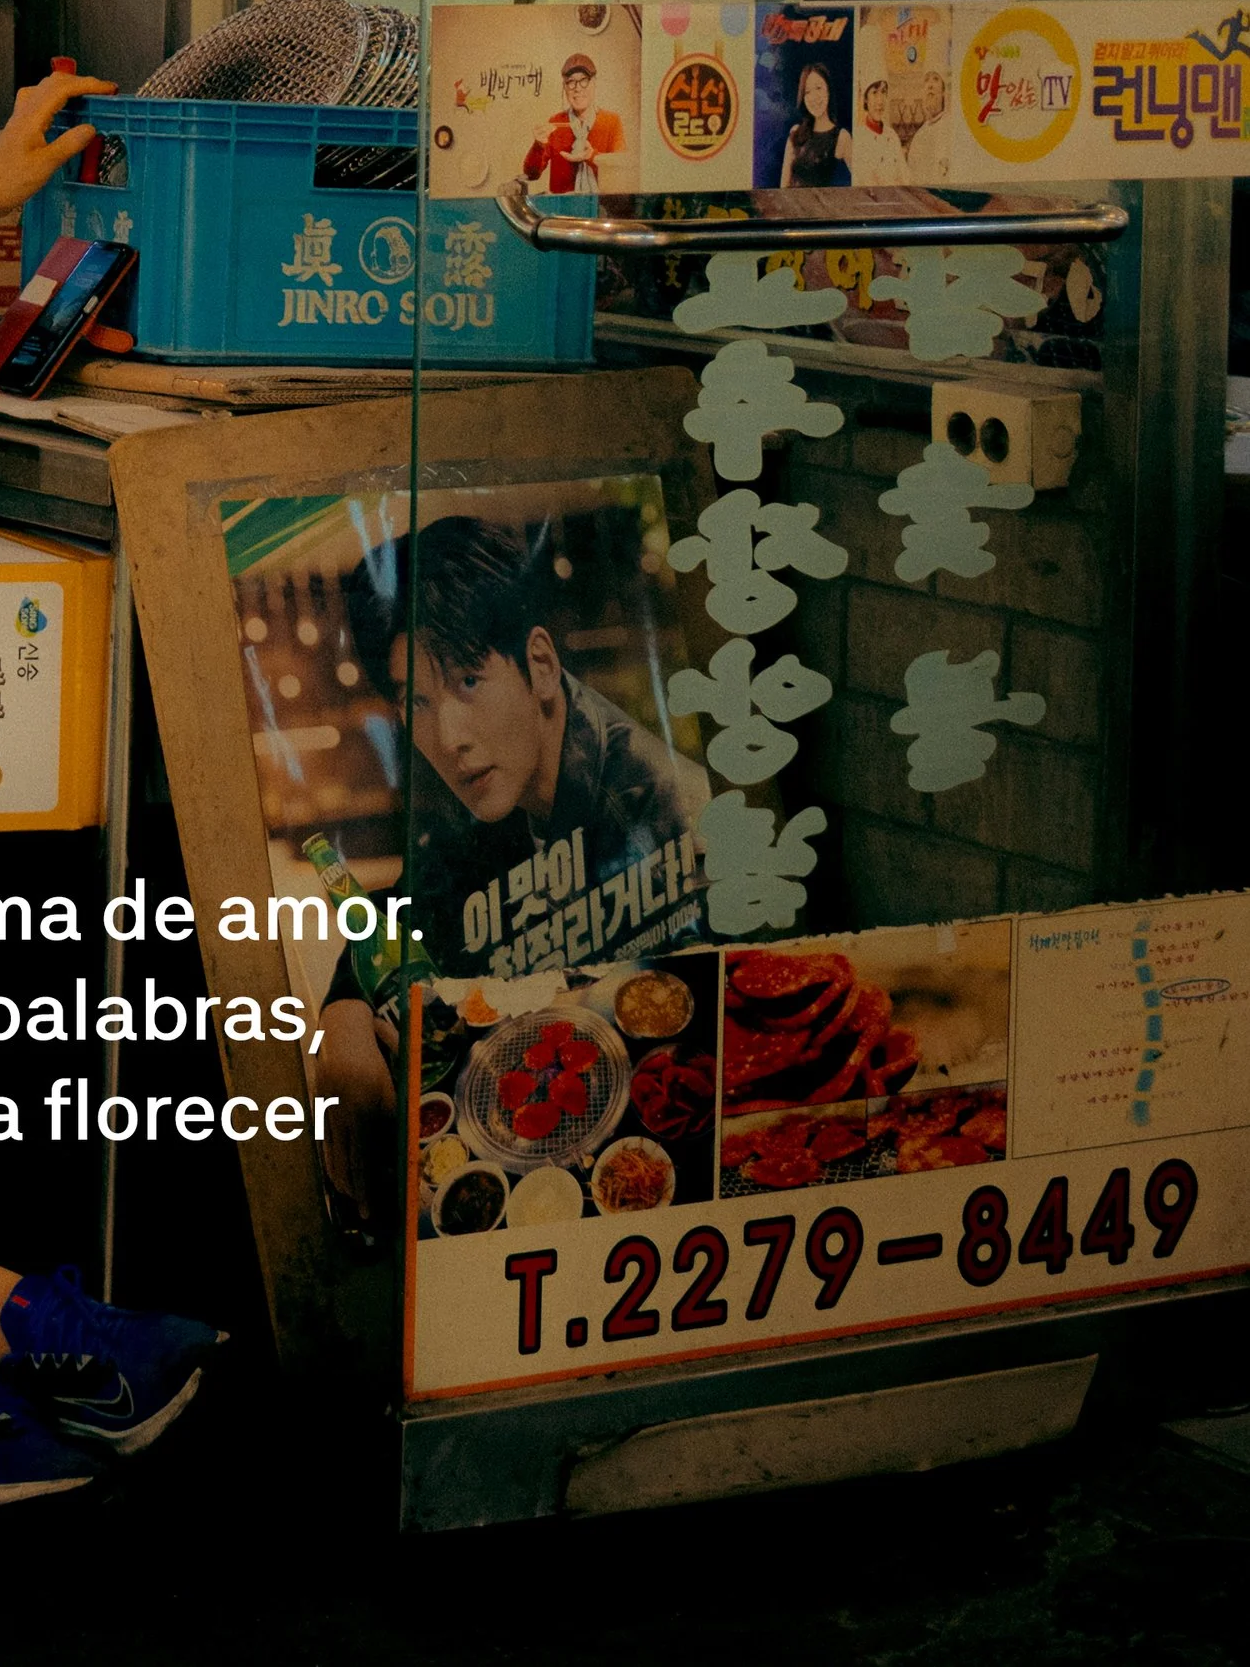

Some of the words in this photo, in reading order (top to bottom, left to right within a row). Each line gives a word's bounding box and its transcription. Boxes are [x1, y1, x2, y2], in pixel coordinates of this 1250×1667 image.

[667, 65, 726, 118] 식신
[976, 64, 1037, 125] 맛있는
[1042, 74, 1073, 107] TV
[1093, 64, 1242, 148] 런닝맨
[278, 289, 389, 327] JINRO
[400, 290, 495, 331] SOJU
[16, 642, 39, 681] 신송
[461, 877, 502, 954] 이
[503, 827, 586, 932] 맛이
[504, 1157, 1201, 1357] T.2279-8449
